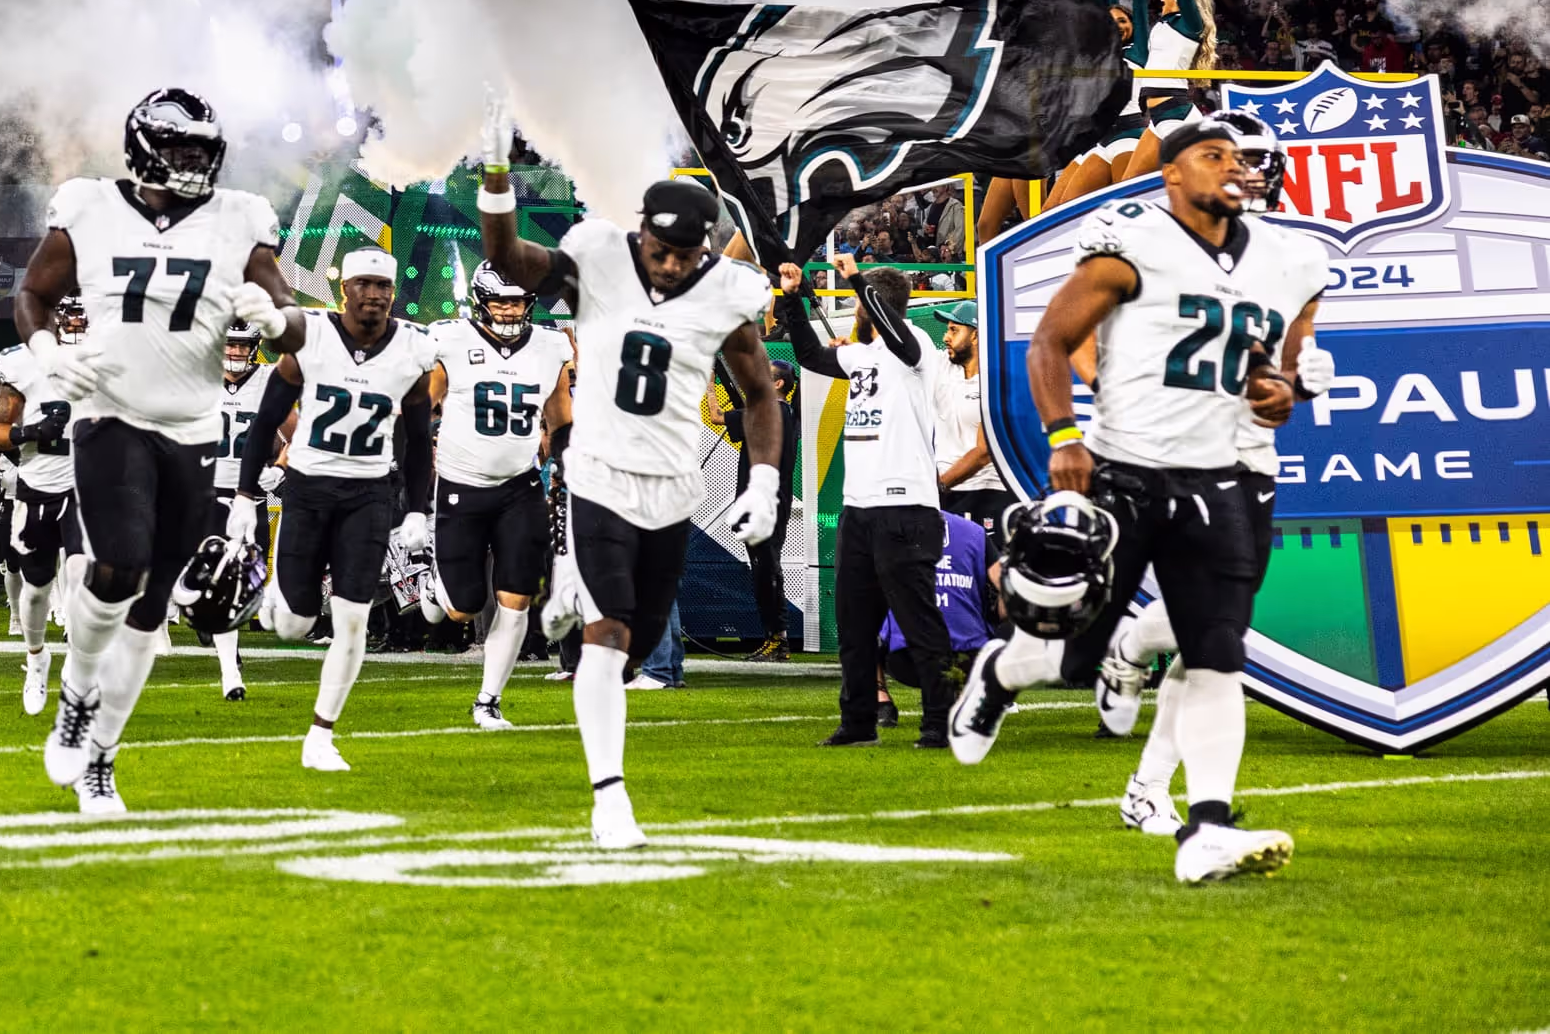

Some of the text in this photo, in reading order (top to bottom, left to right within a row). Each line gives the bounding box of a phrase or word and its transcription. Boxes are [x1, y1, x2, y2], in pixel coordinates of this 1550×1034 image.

[1279, 142, 1424, 223] NFL
[112, 256, 212, 332] 77
[1329, 265, 1415, 291] 024
[615, 330, 673, 416] 8
[1163, 293, 1263, 396] 26
[307, 383, 393, 457] 22
[473, 380, 541, 437] 65
[1274, 450, 1473, 484] GAME
[935, 572, 974, 590] TATION
